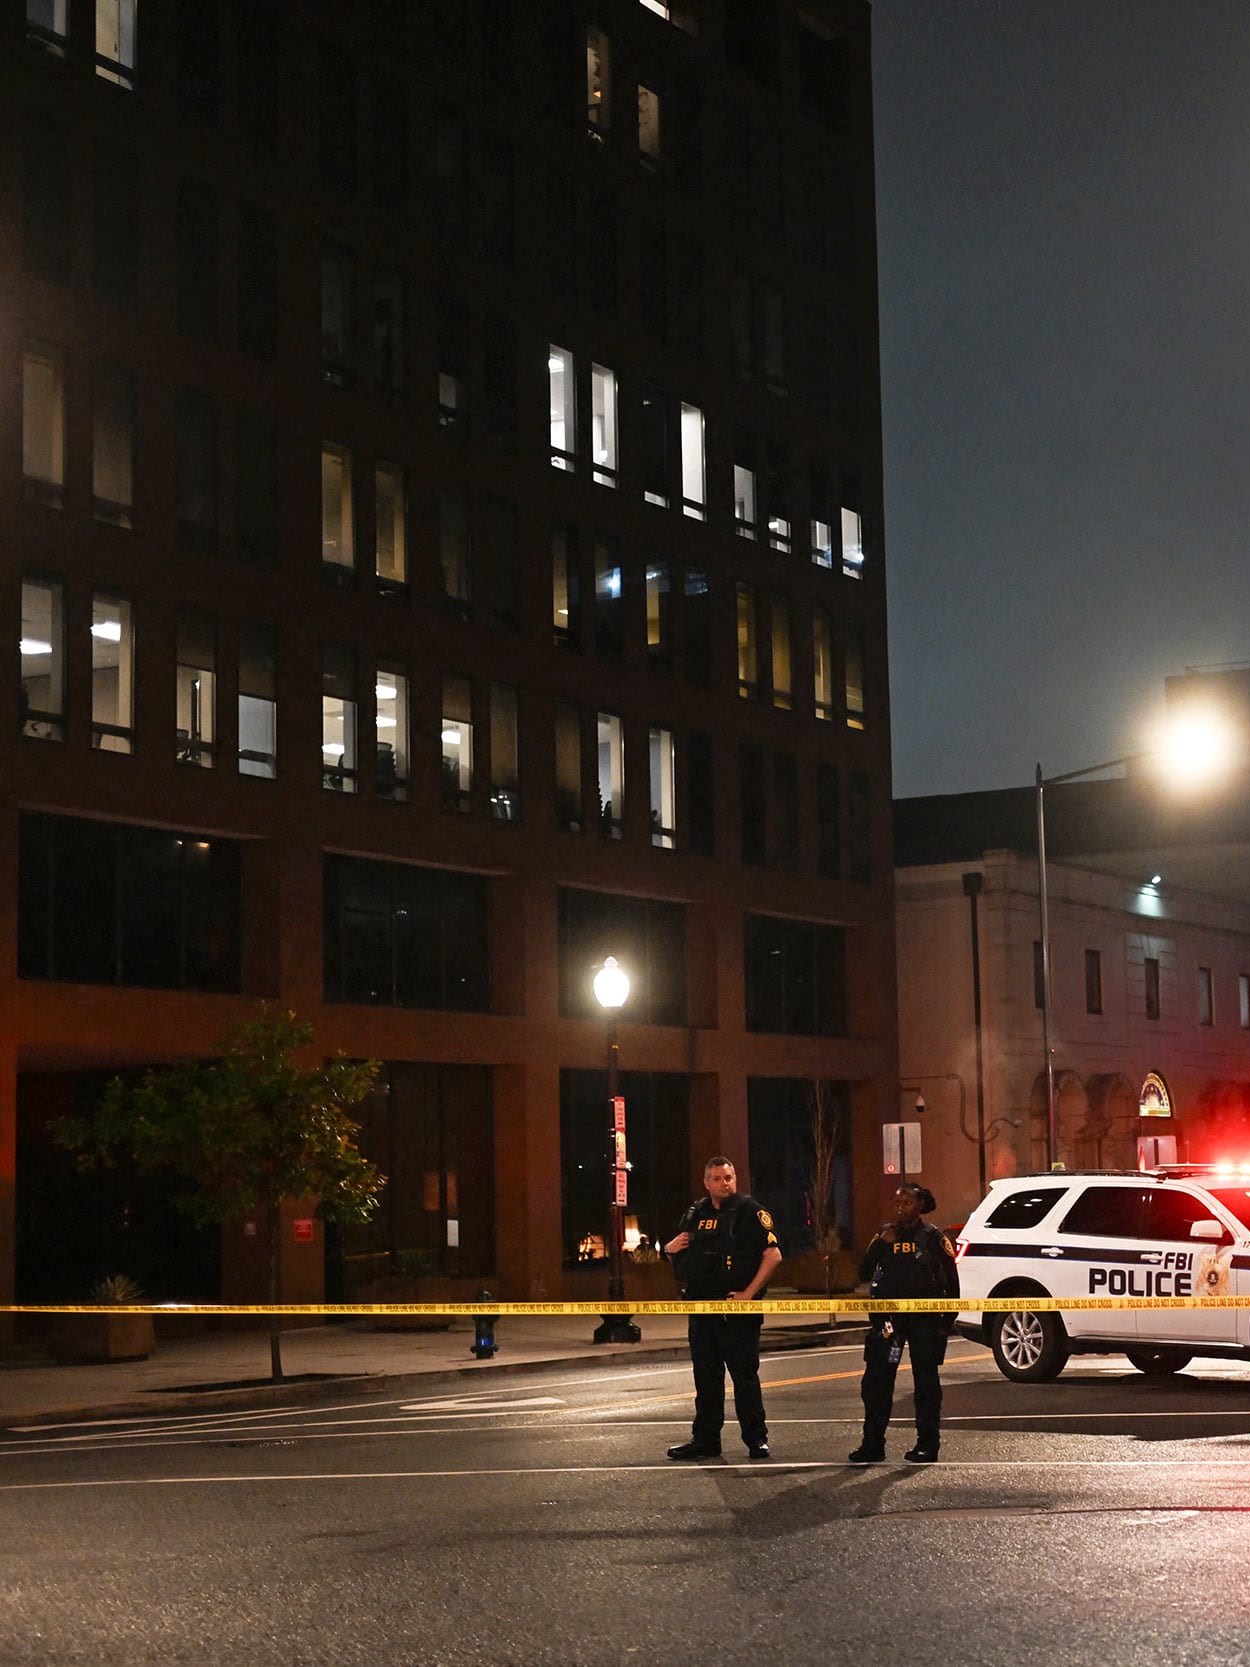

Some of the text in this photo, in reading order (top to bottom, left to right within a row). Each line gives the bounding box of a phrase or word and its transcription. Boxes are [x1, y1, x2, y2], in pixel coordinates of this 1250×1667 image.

[698, 1219, 718, 1230] FBI
[893, 1242, 916, 1254] FBI
[1164, 1252, 1194, 1271] FBI
[1089, 1268, 1192, 1297] POLICE
[1055, 1300, 1070, 1309] POLICE
[1071, 1300, 1080, 1309] LINE
[1098, 1300, 1112, 1308] CROSS
[1127, 1299, 1142, 1308] POLICE
[1143, 1299, 1153, 1308] LINE
[1171, 1299, 1185, 1307] CROSS
[1200, 1298, 1216, 1307] POLICE
[1217, 1298, 1226, 1307] LINE
